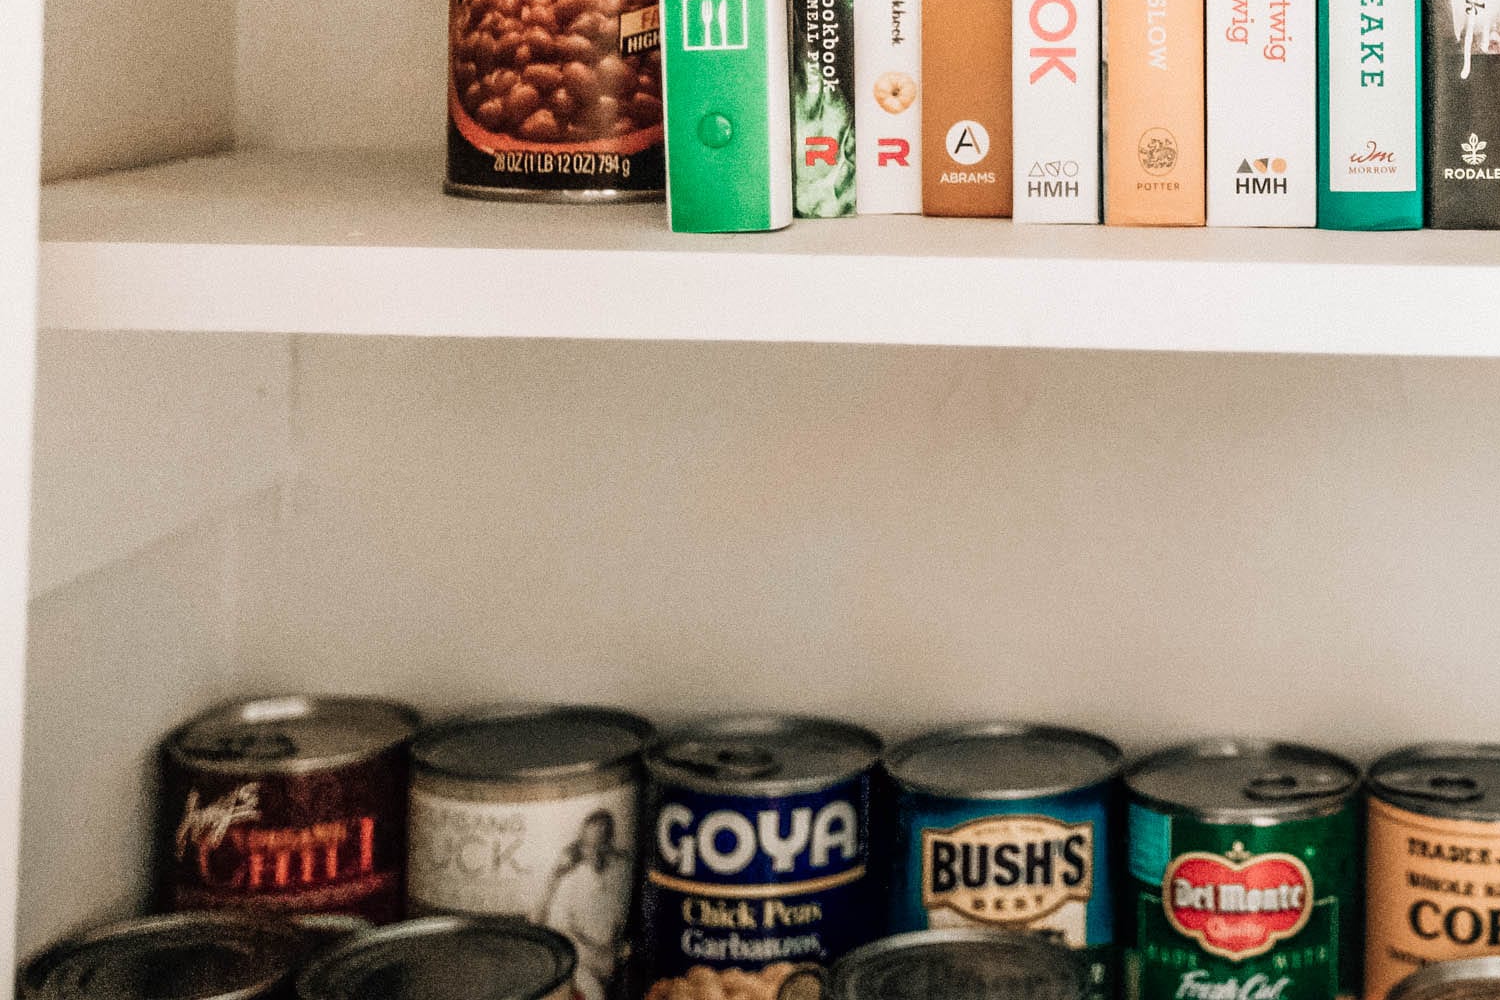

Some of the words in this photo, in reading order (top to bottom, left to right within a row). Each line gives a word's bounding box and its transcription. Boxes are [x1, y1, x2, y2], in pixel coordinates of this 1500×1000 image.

[806, 0, 819, 43] MEAL
[507, 153, 523, 172] OZ
[537, 154, 554, 173] LB
[558, 154, 571, 174] 12
[573, 153, 596, 175] OZ)
[599, 154, 620, 174] 794
[622, 158, 631, 178] g
[1348, 166, 1398, 175] MORROW
[940, 172, 995, 184] ABRAMS
[1137, 182, 1180, 191] POTTER
[1236, 177, 1288, 194] HMH
[1028, 181, 1079, 198] HMH
[658, 800, 857, 876] GOYA
[932, 834, 1085, 893] BUSH'S
